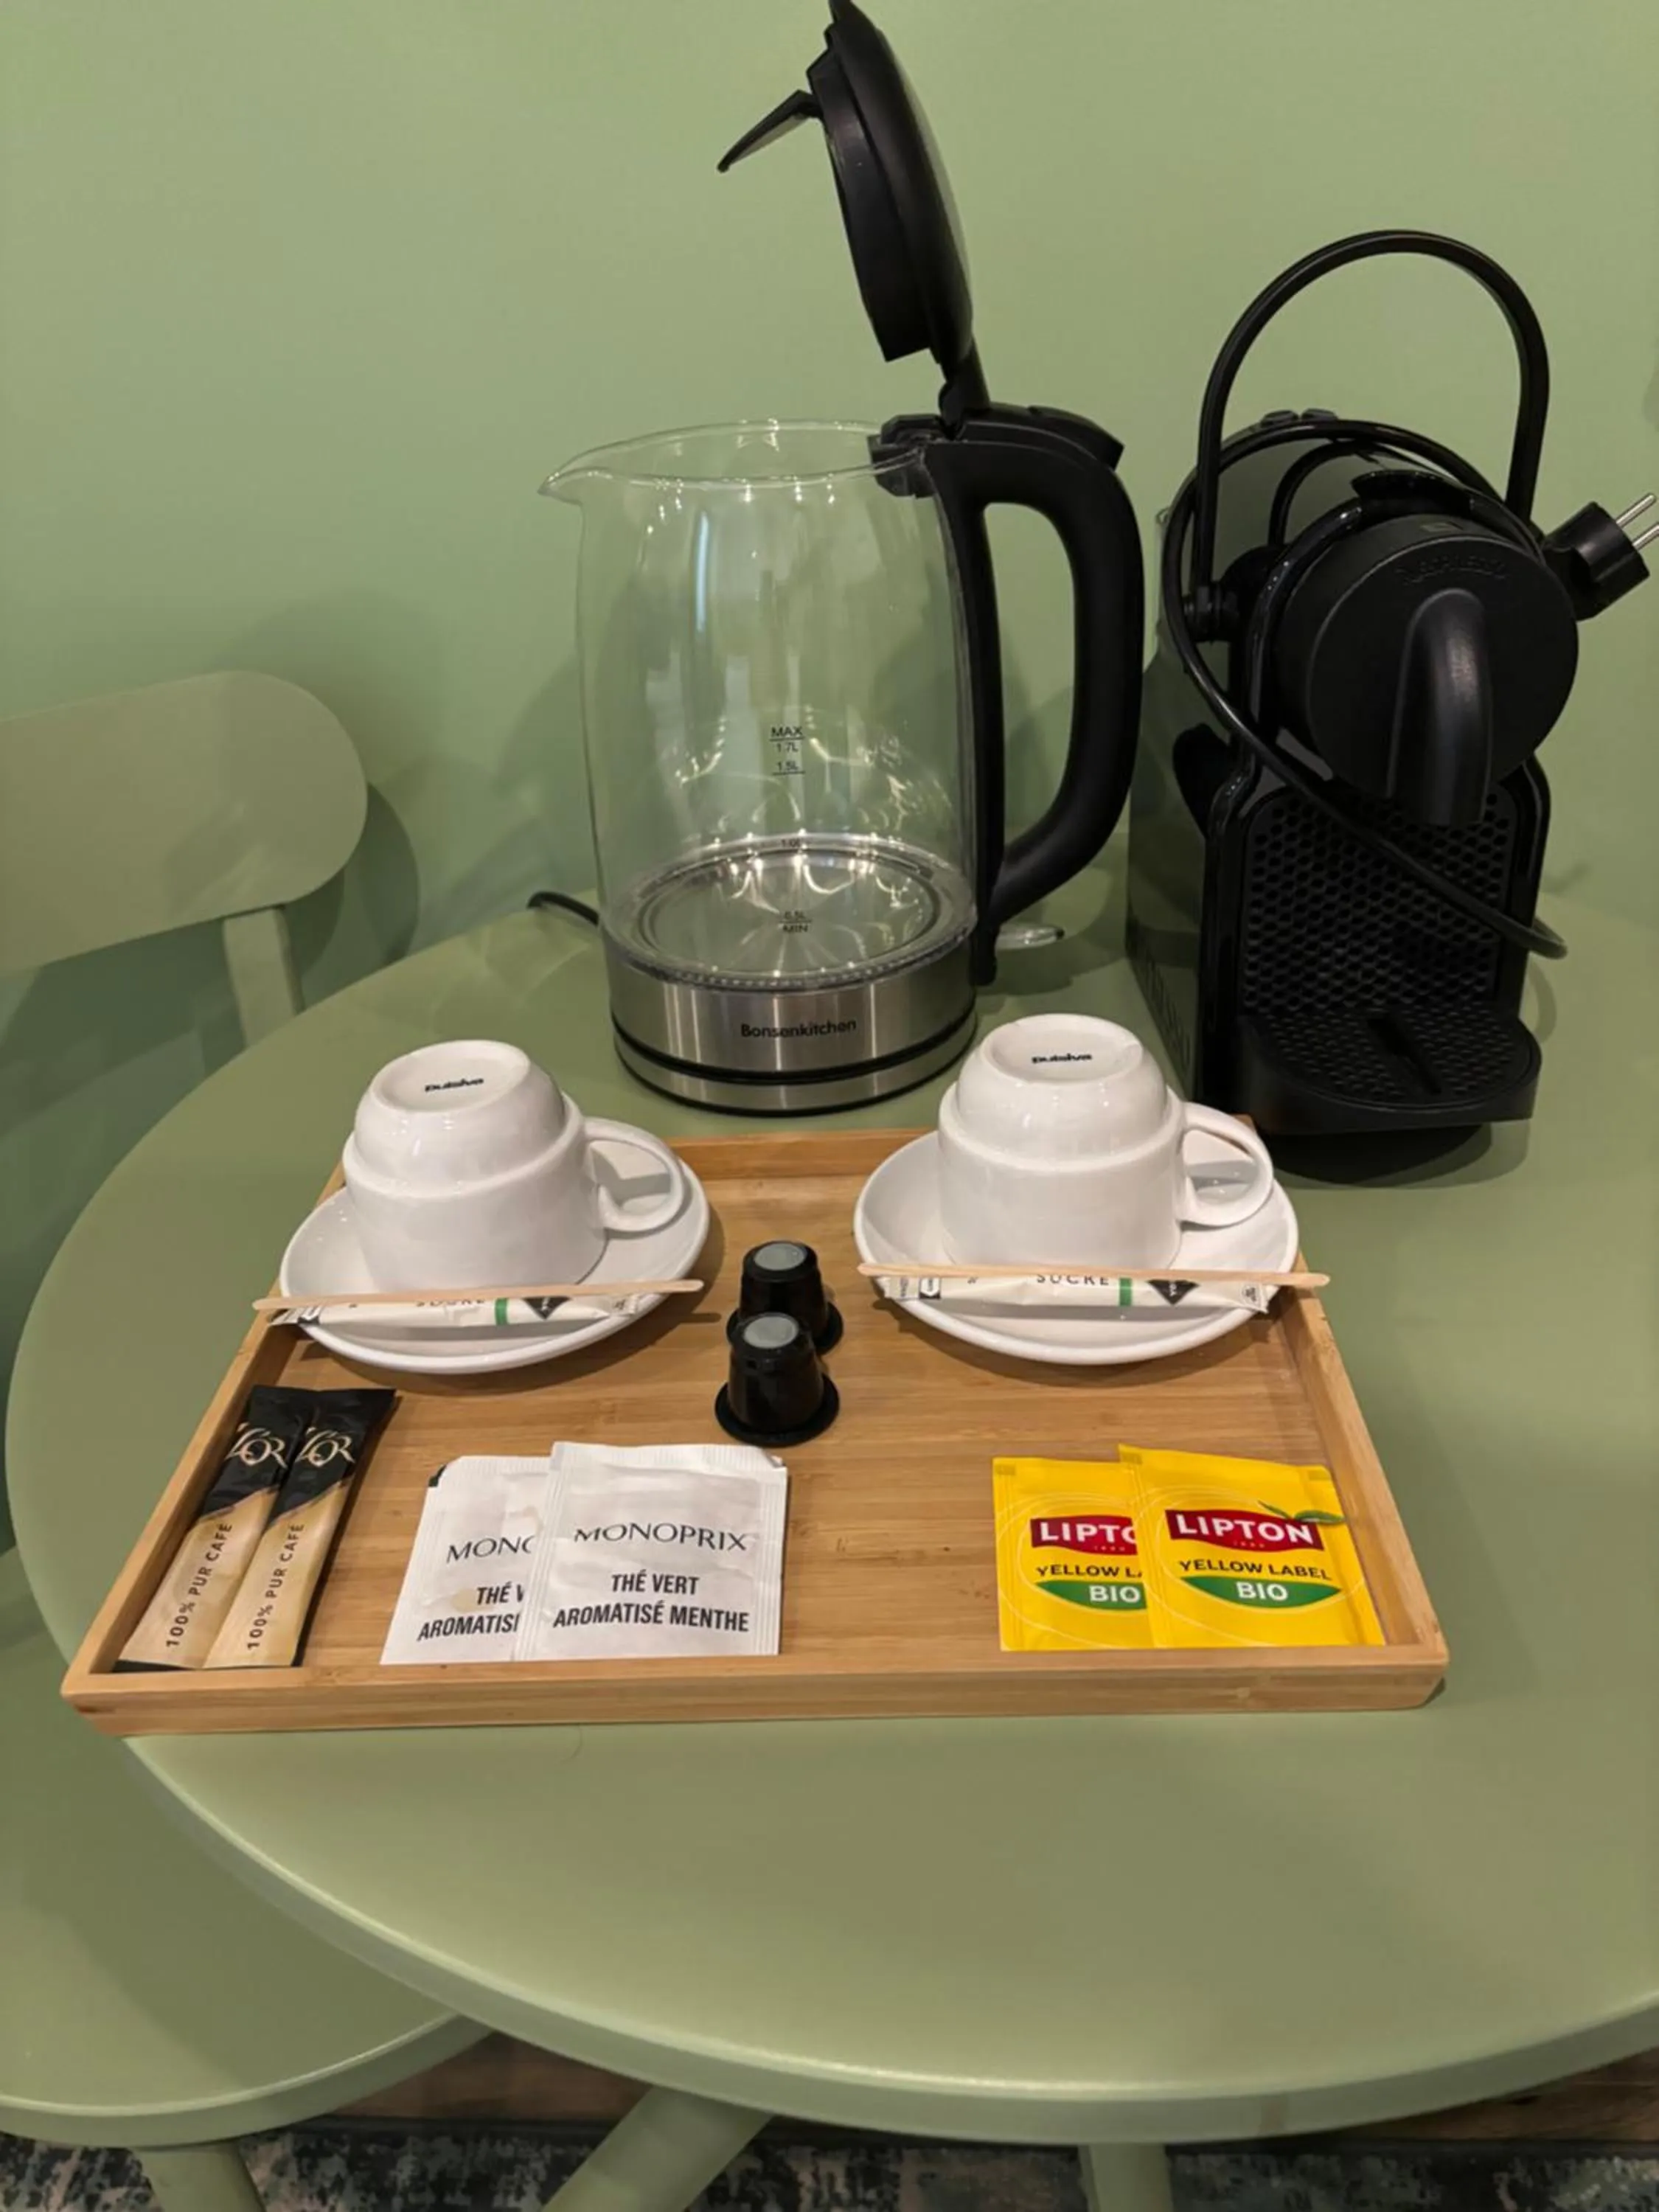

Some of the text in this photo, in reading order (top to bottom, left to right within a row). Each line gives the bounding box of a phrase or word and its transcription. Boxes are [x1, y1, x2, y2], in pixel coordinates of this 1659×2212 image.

[771, 726, 804, 737] MAX
[740, 1020, 858, 1038] Bonsenkitchen
[574, 1523, 751, 1551] MONOPRIX
[1175, 1513, 1315, 1545] LIPTON
[611, 1568, 700, 1596] THÉ VERT
[1036, 1563, 1120, 1578] YELLOW
[1180, 1559, 1333, 1582] YELLOW LABEL
[476, 1581, 512, 1607] THÉ
[1088, 1585, 1141, 1604] BIO
[1237, 1581, 1289, 1602] BIO
[166, 1602, 196, 1648] 100%
[188, 1567, 213, 1596] PUR
[247, 1605, 274, 1650] 100%
[265, 1568, 288, 1599] PUR
[553, 1599, 751, 1632] AROMATISÉ MENTHE
